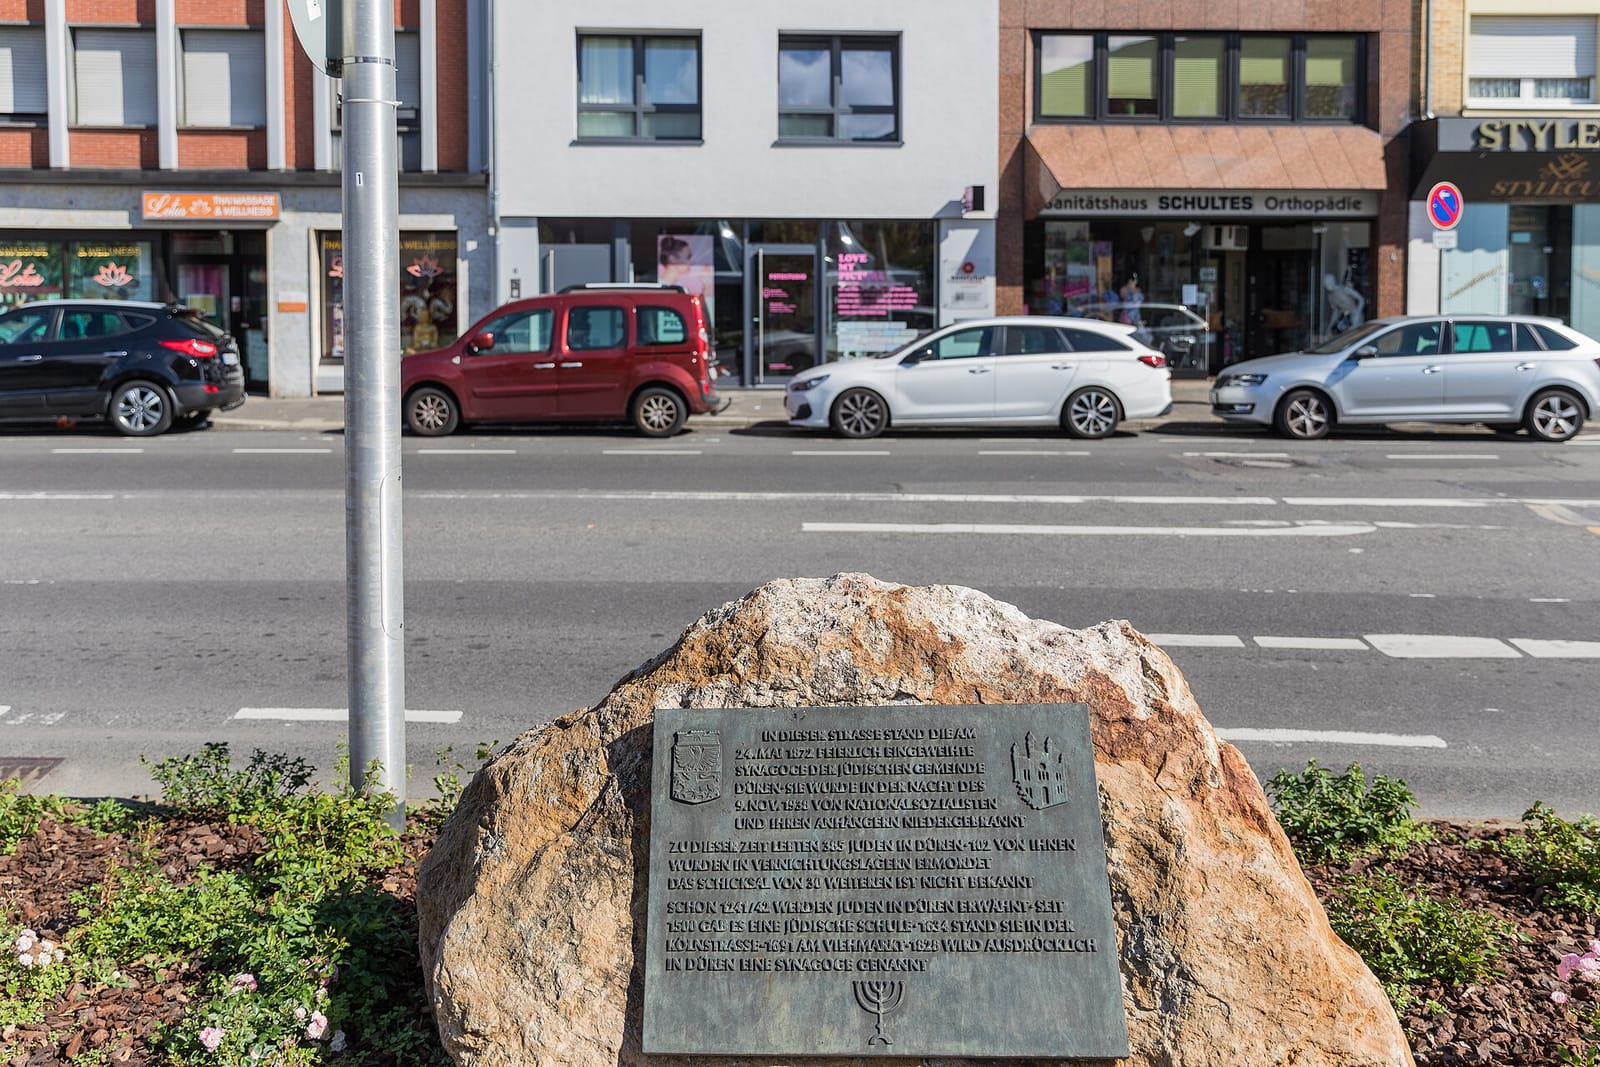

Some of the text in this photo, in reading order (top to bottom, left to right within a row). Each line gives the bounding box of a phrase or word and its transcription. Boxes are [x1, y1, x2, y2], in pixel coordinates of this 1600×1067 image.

[1479, 120, 1600, 149] STYLE
[148, 193, 186, 217] Lotus
[1158, 195, 1254, 211] SCHULTES
[1264, 194, 1362, 214] Orthopädie
[224, 207, 274, 217] WELLNESS
[838, 253, 868, 263] LOVE
[762, 727, 977, 742] IN DIESER STRASSE STAND DIE AM
[816, 747, 882, 760] FEIERLICH
[884, 745, 975, 758] EINGEWEIHTE
[735, 762, 985, 778] SYNAGOGE DER JÜDISCHEN GEMEINDE
[807, 782, 858, 794] WURDE
[859, 782, 876, 793] IN
[877, 781, 906, 793] DER
[907, 780, 957, 793] NACHT
[958, 780, 985, 792] DES
[812, 799, 845, 811] VON
[845, 798, 998, 811] NATIONALSOZIALISTEN
[734, 815, 1026, 830] UND IHREN ANHÄNGERN NIEDERGEBRANNT
[669, 841, 690, 853] ZU
[691, 841, 738, 853] DIESER
[739, 841, 769, 853] ZEIT
[771, 840, 819, 853] LEBTEN
[848, 840, 894, 854] JUDEN
[896, 839, 912, 851] IN
[992, 839, 1026, 851] VON
[1028, 838, 1077, 851] IHNEN
[668, 859, 730, 871] WURDEN
[732, 859, 749, 871] IN
[915, 857, 992, 870] ERMORDET
[668, 877, 694, 890] DAS
[697, 877, 771, 890] SCHICKSAL
[773, 877, 804, 889] VON
[824, 876, 892, 889] WEITEREN
[895, 876, 918, 888] IST
[921, 876, 966, 888] NICHT
[968, 876, 1035, 888] BEKANNT
[667, 901, 717, 914] SCHON
[772, 901, 834, 914] WERDEN
[837, 901, 885, 915] JUDEN
[887, 901, 905, 913] IN
[906, 898, 957, 913] DÜREN
[698, 920, 728, 933] GAB
[729, 920, 745, 933] ES
[748, 920, 781, 932] EINE
[784, 917, 855, 935] JÜDISCHE
[951, 920, 999, 932] STAND
[1000, 919, 1025, 932] SIE
[1025, 919, 1043, 932] IN
[1044, 919, 1076, 932] DER
[795, 939, 821, 953] AM
[941, 938, 982, 952] WIRD
[984, 936, 1097, 953] AUSDRÜCKLICH
[665, 956, 928, 972] IN DÜREN EINE SYNAGOGE GENANNT
